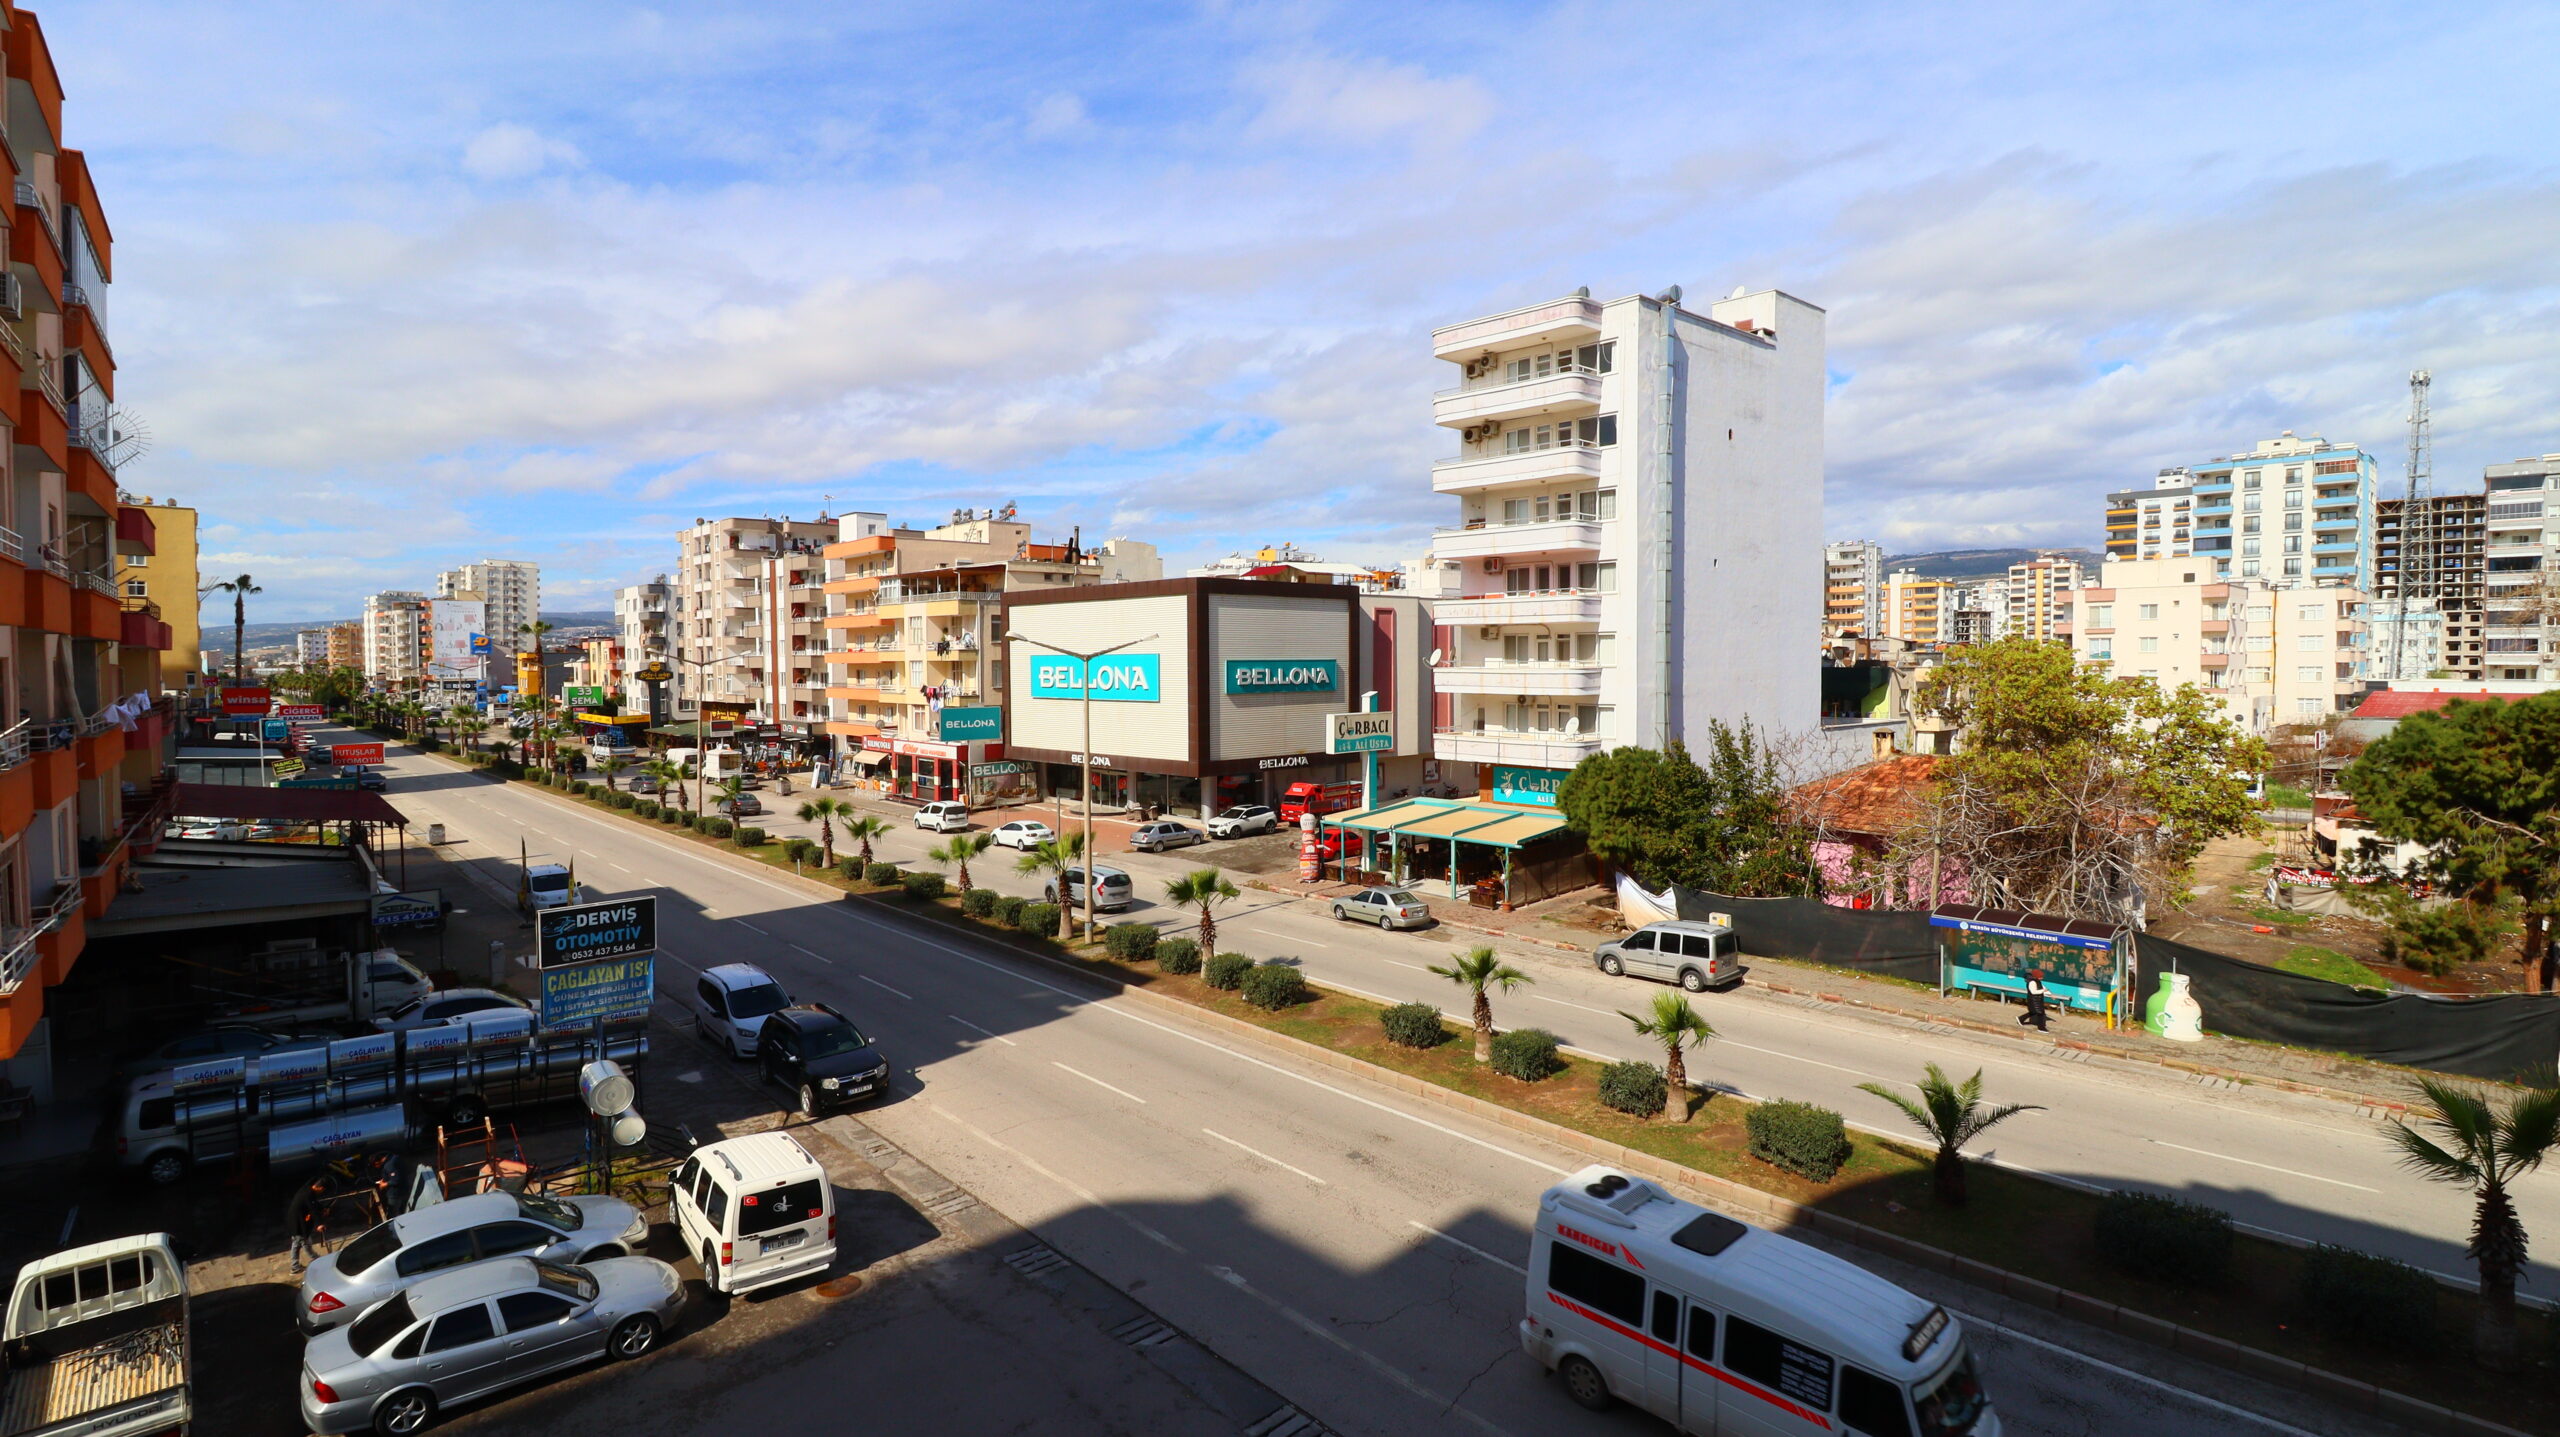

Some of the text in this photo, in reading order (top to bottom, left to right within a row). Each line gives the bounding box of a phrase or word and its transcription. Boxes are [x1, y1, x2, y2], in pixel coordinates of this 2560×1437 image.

[1038, 666, 1149, 690] BELLONA
[1236, 667, 1330, 686] BELLONA
[577, 687, 592, 696] 33
[227, 696, 266, 704] winsa
[283, 706, 319, 714] CİĞERCİ
[946, 719, 995, 728] BELLONA
[334, 756, 382, 764] OTOMOTİV
[1259, 756, 1309, 769] BELLONA
[973, 762, 1034, 776] BELLONA
[576, 905, 637, 927] DERVİŞ
[556, 924, 641, 950] OTOMOTİV
[572, 949, 593, 959] 0532
[595, 947, 611, 956] 437
[613, 944, 623, 953] 54
[547, 960, 649, 996] ÇAĞLAYAN ISI
[93, 1404, 162, 1431] HYUNDAI
